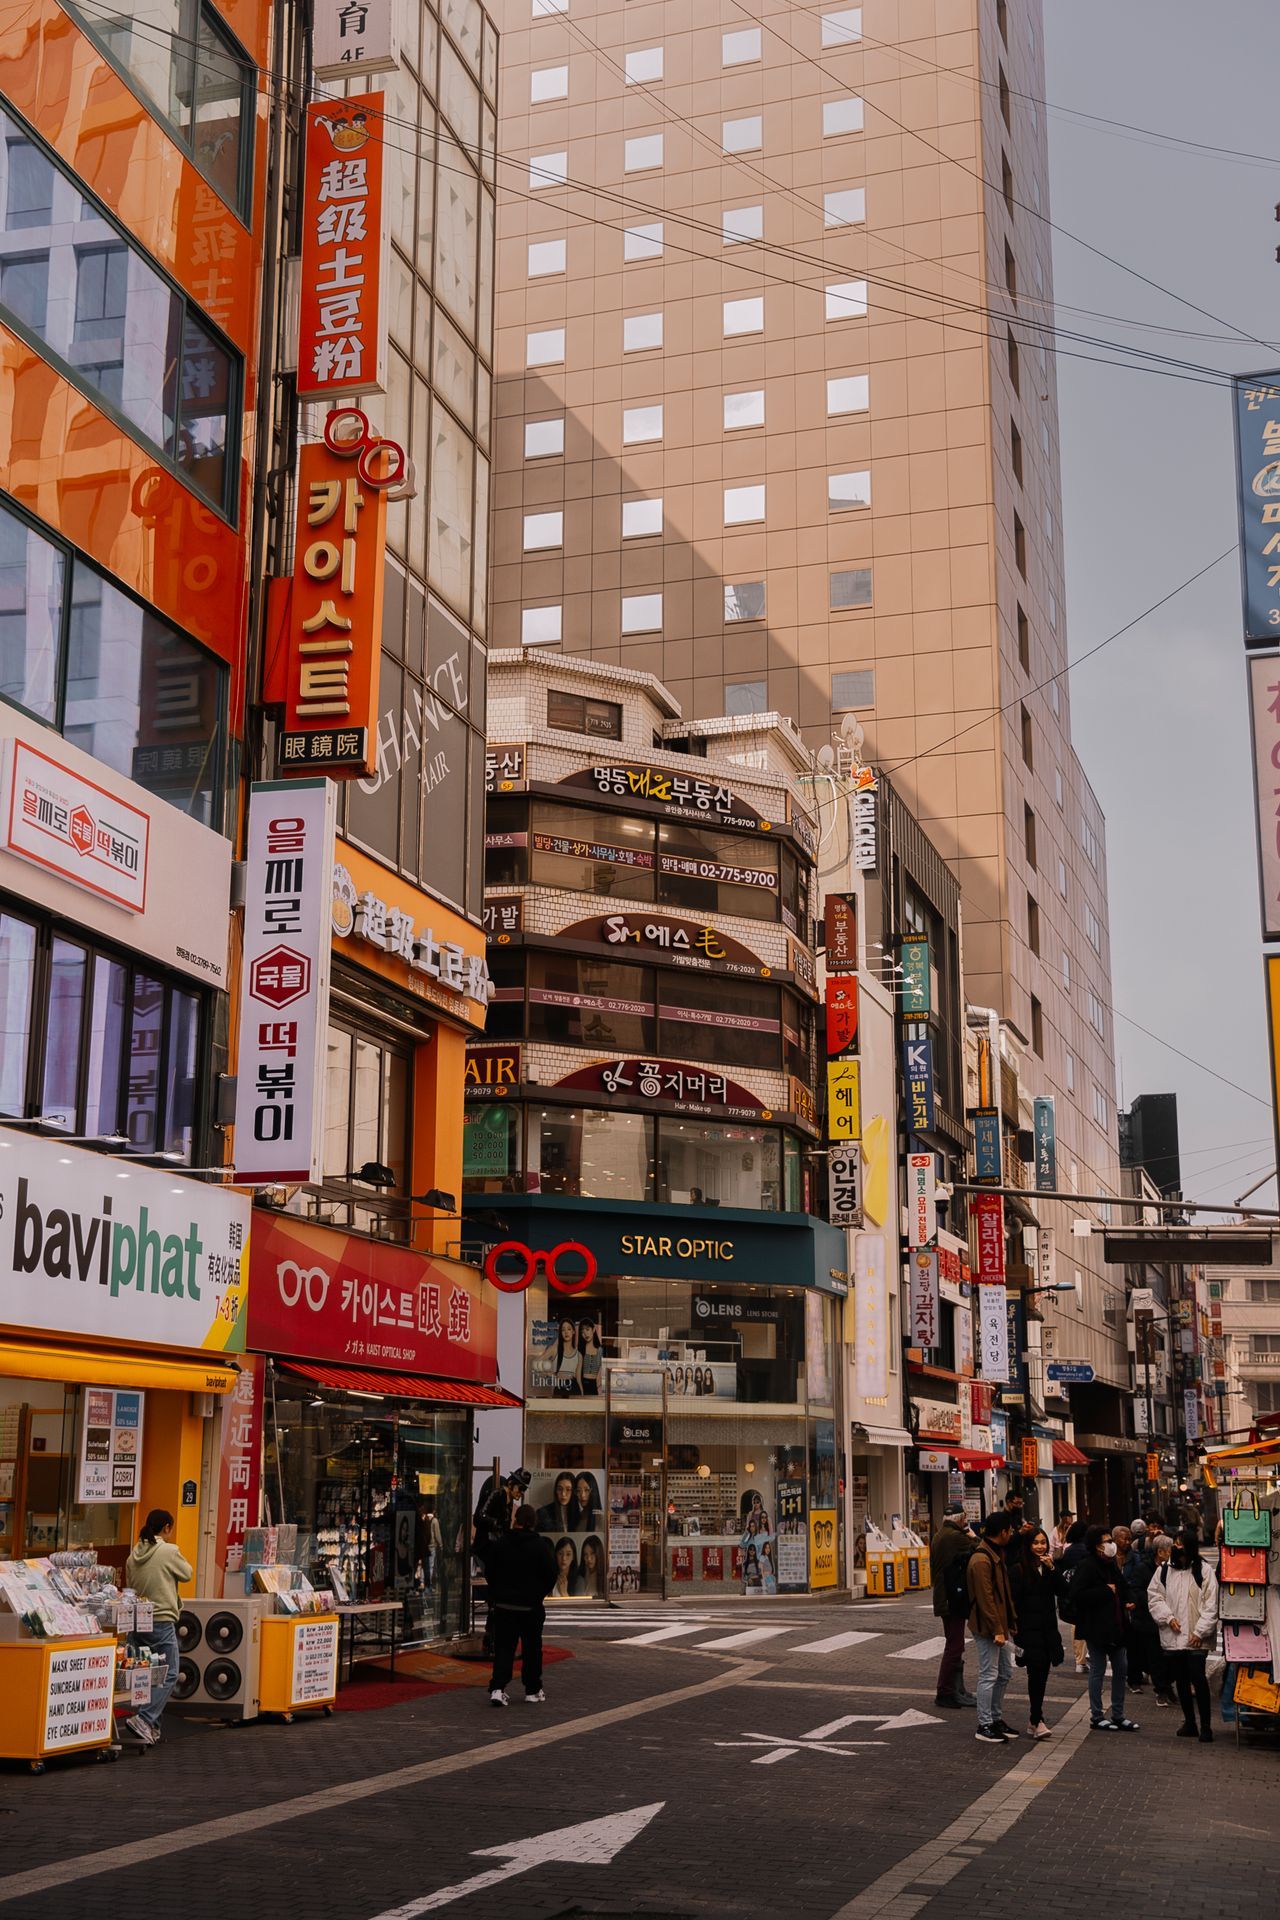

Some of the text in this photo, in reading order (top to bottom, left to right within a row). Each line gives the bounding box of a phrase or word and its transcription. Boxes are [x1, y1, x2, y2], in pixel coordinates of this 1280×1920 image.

[341, 47, 364, 61] 4F
[311, 158, 369, 382] 超级土豆粉
[296, 478, 364, 717] 카이스트
[284, 733, 359, 759] 眼鏡院
[72, 817, 92, 843] 국물
[723, 816, 755, 828] 775-9700
[855, 792, 876, 870] CHICKEN
[97, 829, 139, 872] 떡볶이
[700, 863, 775, 887] 02-775-9700
[484, 905, 518, 930] 가발
[357, 891, 491, 1006] 超级土豆粉
[834, 921, 848, 957] 부동산
[259, 965, 301, 989] 국물
[726, 963, 755, 974] 776-2020
[608, 1001, 645, 1013] 02.776-2020
[715, 1015, 751, 1026] 02.776-2020
[836, 1012, 850, 1043] 가발
[908, 1046, 927, 1066] K
[254, 1021, 298, 1142] 떡볶이
[638, 1062, 727, 1104] 꽁지머리
[728, 1107, 756, 1117] 777-9079
[836, 1088, 853, 1135] 헤어
[911, 1081, 928, 1129] 비뇨기과
[982, 1130, 994, 1173] 세탁소
[832, 1159, 857, 1211] 안경
[12, 1176, 204, 1302] baviphat
[621, 1235, 734, 1260] STAR OPTIC
[340, 1279, 414, 1329] 카이스트
[915, 1293, 935, 1345] 감자탕
[366, 1342, 381, 1356] KAIST
[382, 1344, 401, 1358] OPTICAL
[402, 1347, 416, 1361] SHOP
[206, 1376, 227, 1389] baviphat
[115, 1471, 133, 1482] COSRX
[186, 1492, 194, 1503] 29
[676, 1557, 690, 1567] SALE
[707, 1557, 720, 1566] SALE
[52, 1656, 109, 1674] MASK SHEET KRW250
[50, 1680, 81, 1695] SUNCREAM
[49, 1703, 65, 1718] HAND
[66, 1700, 86, 1715] CREAM
[47, 1727, 58, 1740] EYE
[59, 1723, 80, 1737] CREAM
